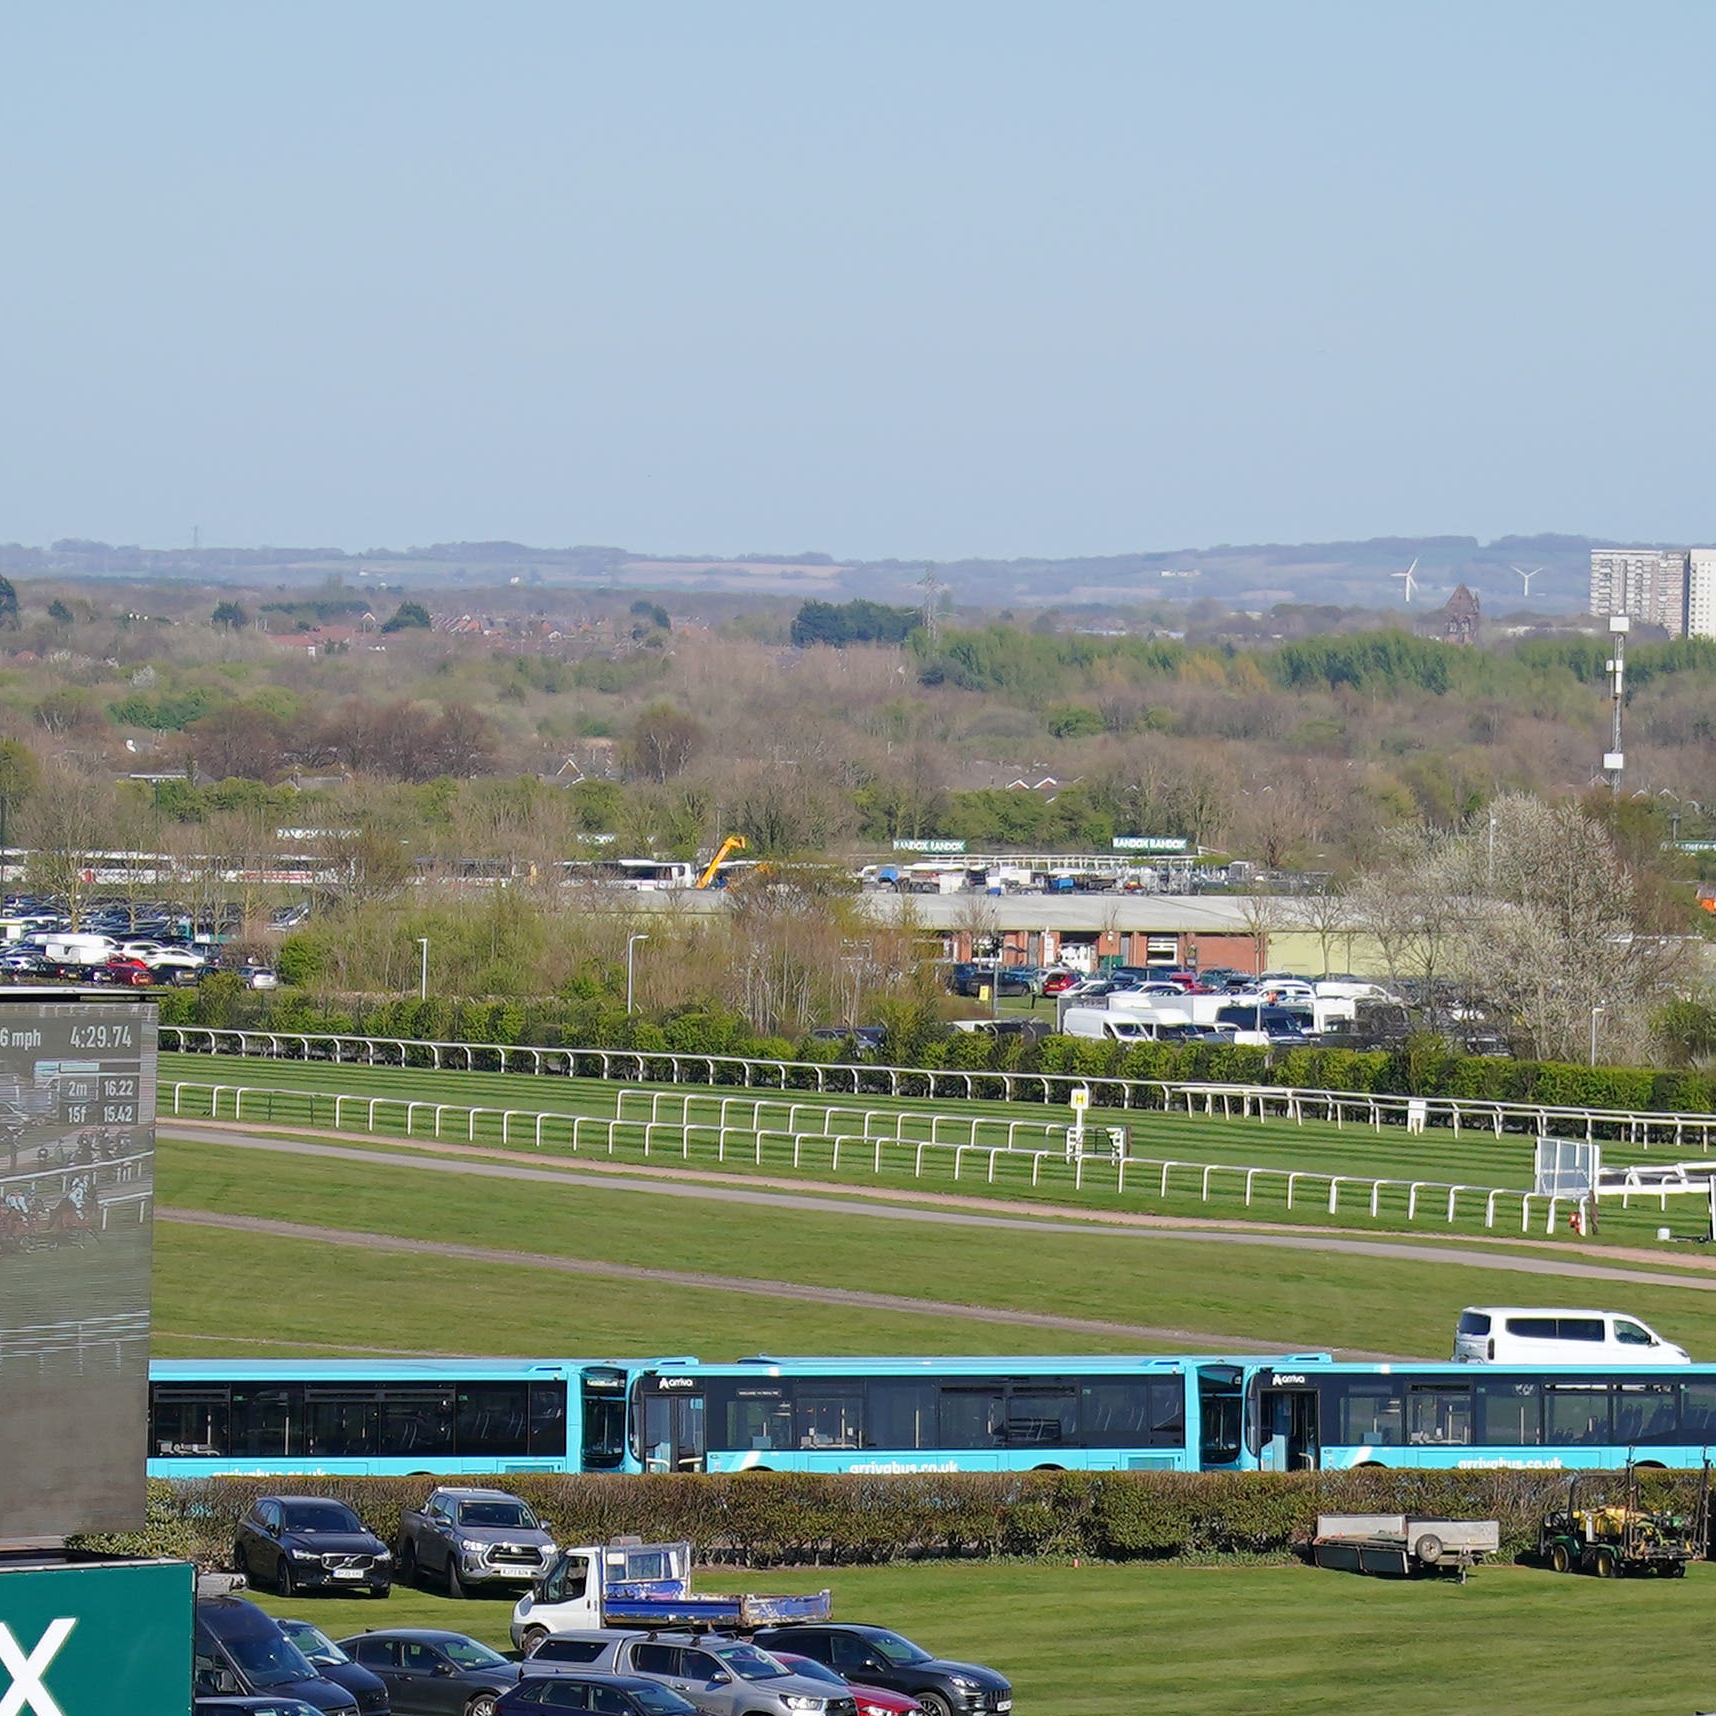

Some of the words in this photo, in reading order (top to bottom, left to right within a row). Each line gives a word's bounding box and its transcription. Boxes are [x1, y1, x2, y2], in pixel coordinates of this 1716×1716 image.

[11, 1029, 41, 1051] mph
[70, 1025, 132, 1048] 4:29.74
[68, 1081, 88, 1097] 2m
[104, 1080, 134, 1097] 16.22
[1075, 1095, 1084, 1104] H
[104, 1105, 133, 1122] 15.42
